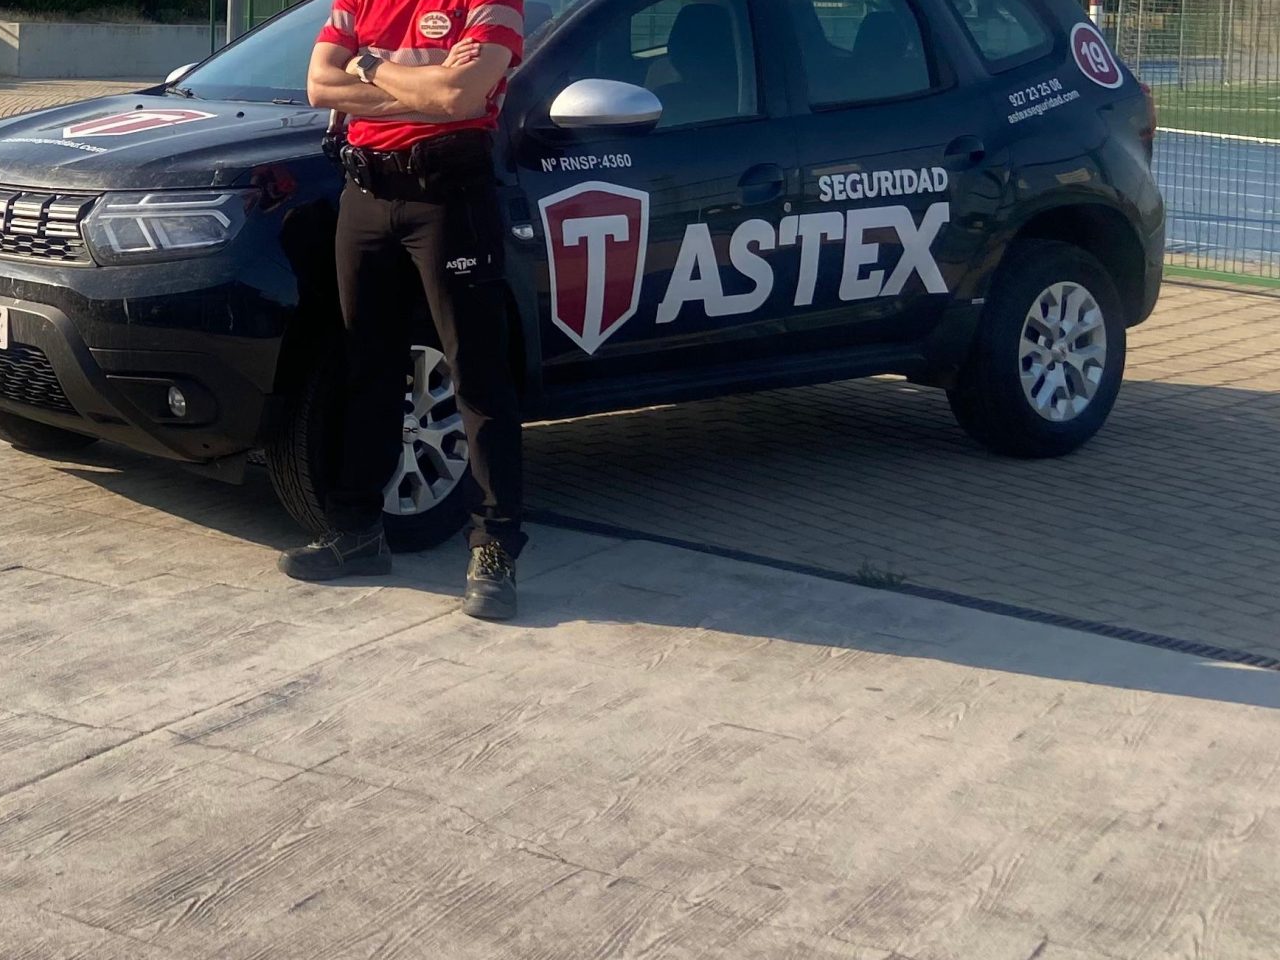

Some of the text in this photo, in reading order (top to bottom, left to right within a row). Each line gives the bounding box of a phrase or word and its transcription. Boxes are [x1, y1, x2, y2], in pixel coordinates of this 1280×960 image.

[1081, 41, 1109, 73] 19
[1008, 78, 1062, 107] 927 23 25 08
[1008, 90, 1080, 124] astexseguridad.com
[560, 153, 632, 172] RNSP:4360
[819, 167, 949, 202] SEGURIDAD
[446, 257, 477, 270] ASTEX
[656, 202, 950, 324] ASTEX
